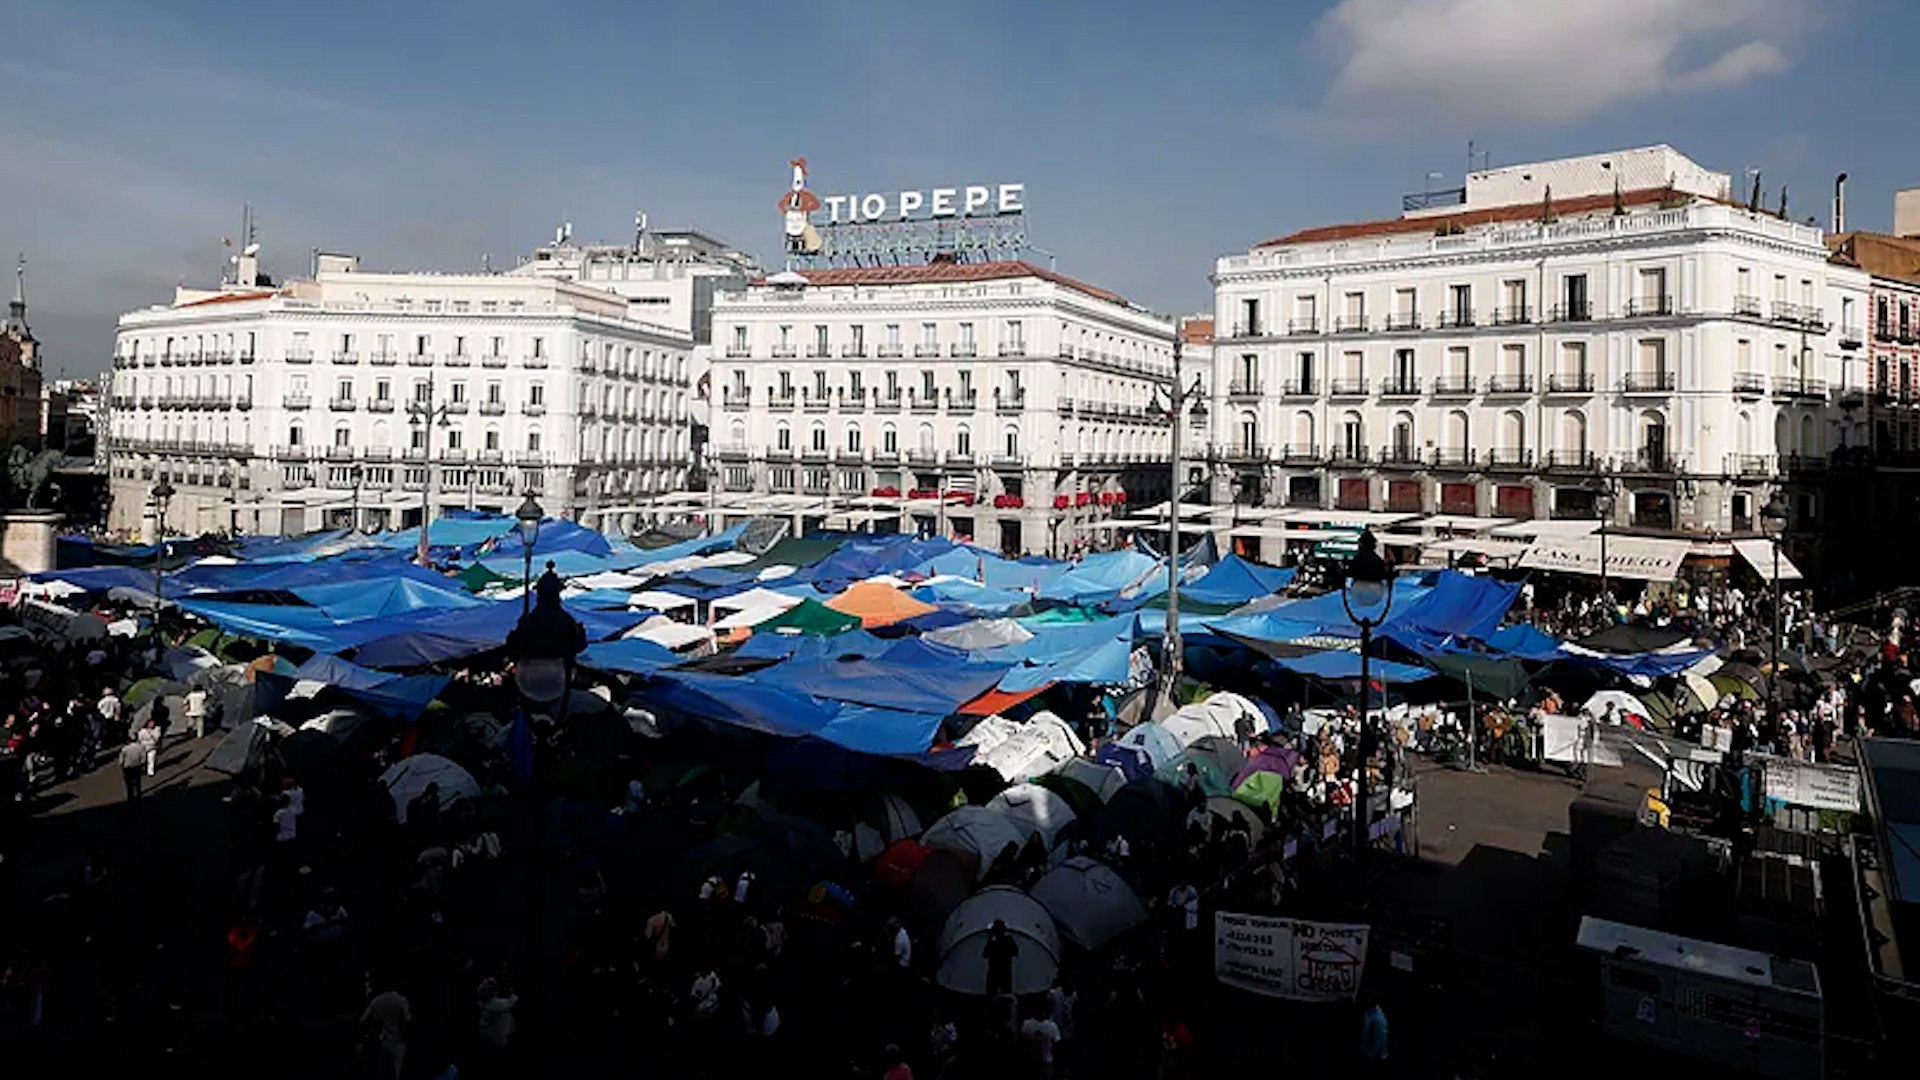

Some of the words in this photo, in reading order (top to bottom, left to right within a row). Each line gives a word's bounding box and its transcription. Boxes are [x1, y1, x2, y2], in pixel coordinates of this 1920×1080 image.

[824, 193, 886, 222] TIO
[900, 183, 1024, 218] PEPE
[1532, 547, 1581, 562] CASA
[1605, 555, 1671, 568] DIEGO
[1292, 922, 1315, 938] NO
